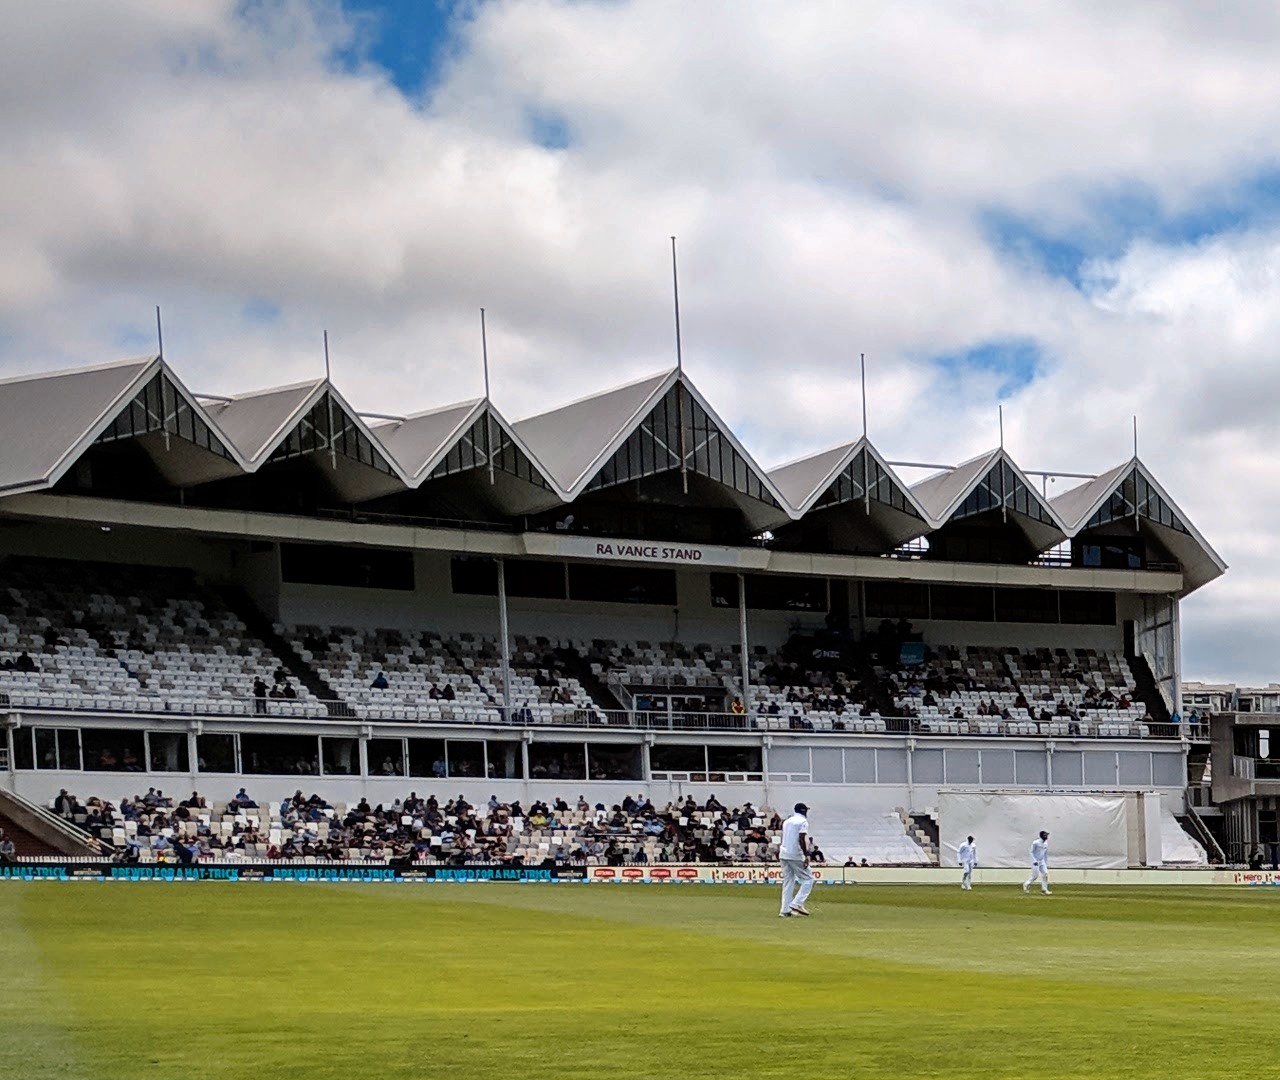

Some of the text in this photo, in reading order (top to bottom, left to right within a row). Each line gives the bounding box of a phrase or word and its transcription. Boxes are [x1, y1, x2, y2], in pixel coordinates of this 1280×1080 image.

[596, 543, 702, 560] RA VANCE STAND
[185, 867, 239, 879] HAT-TRICK
[347, 869, 395, 879] HAT-TRICK
[503, 869, 551, 879] HAT-TRICK
